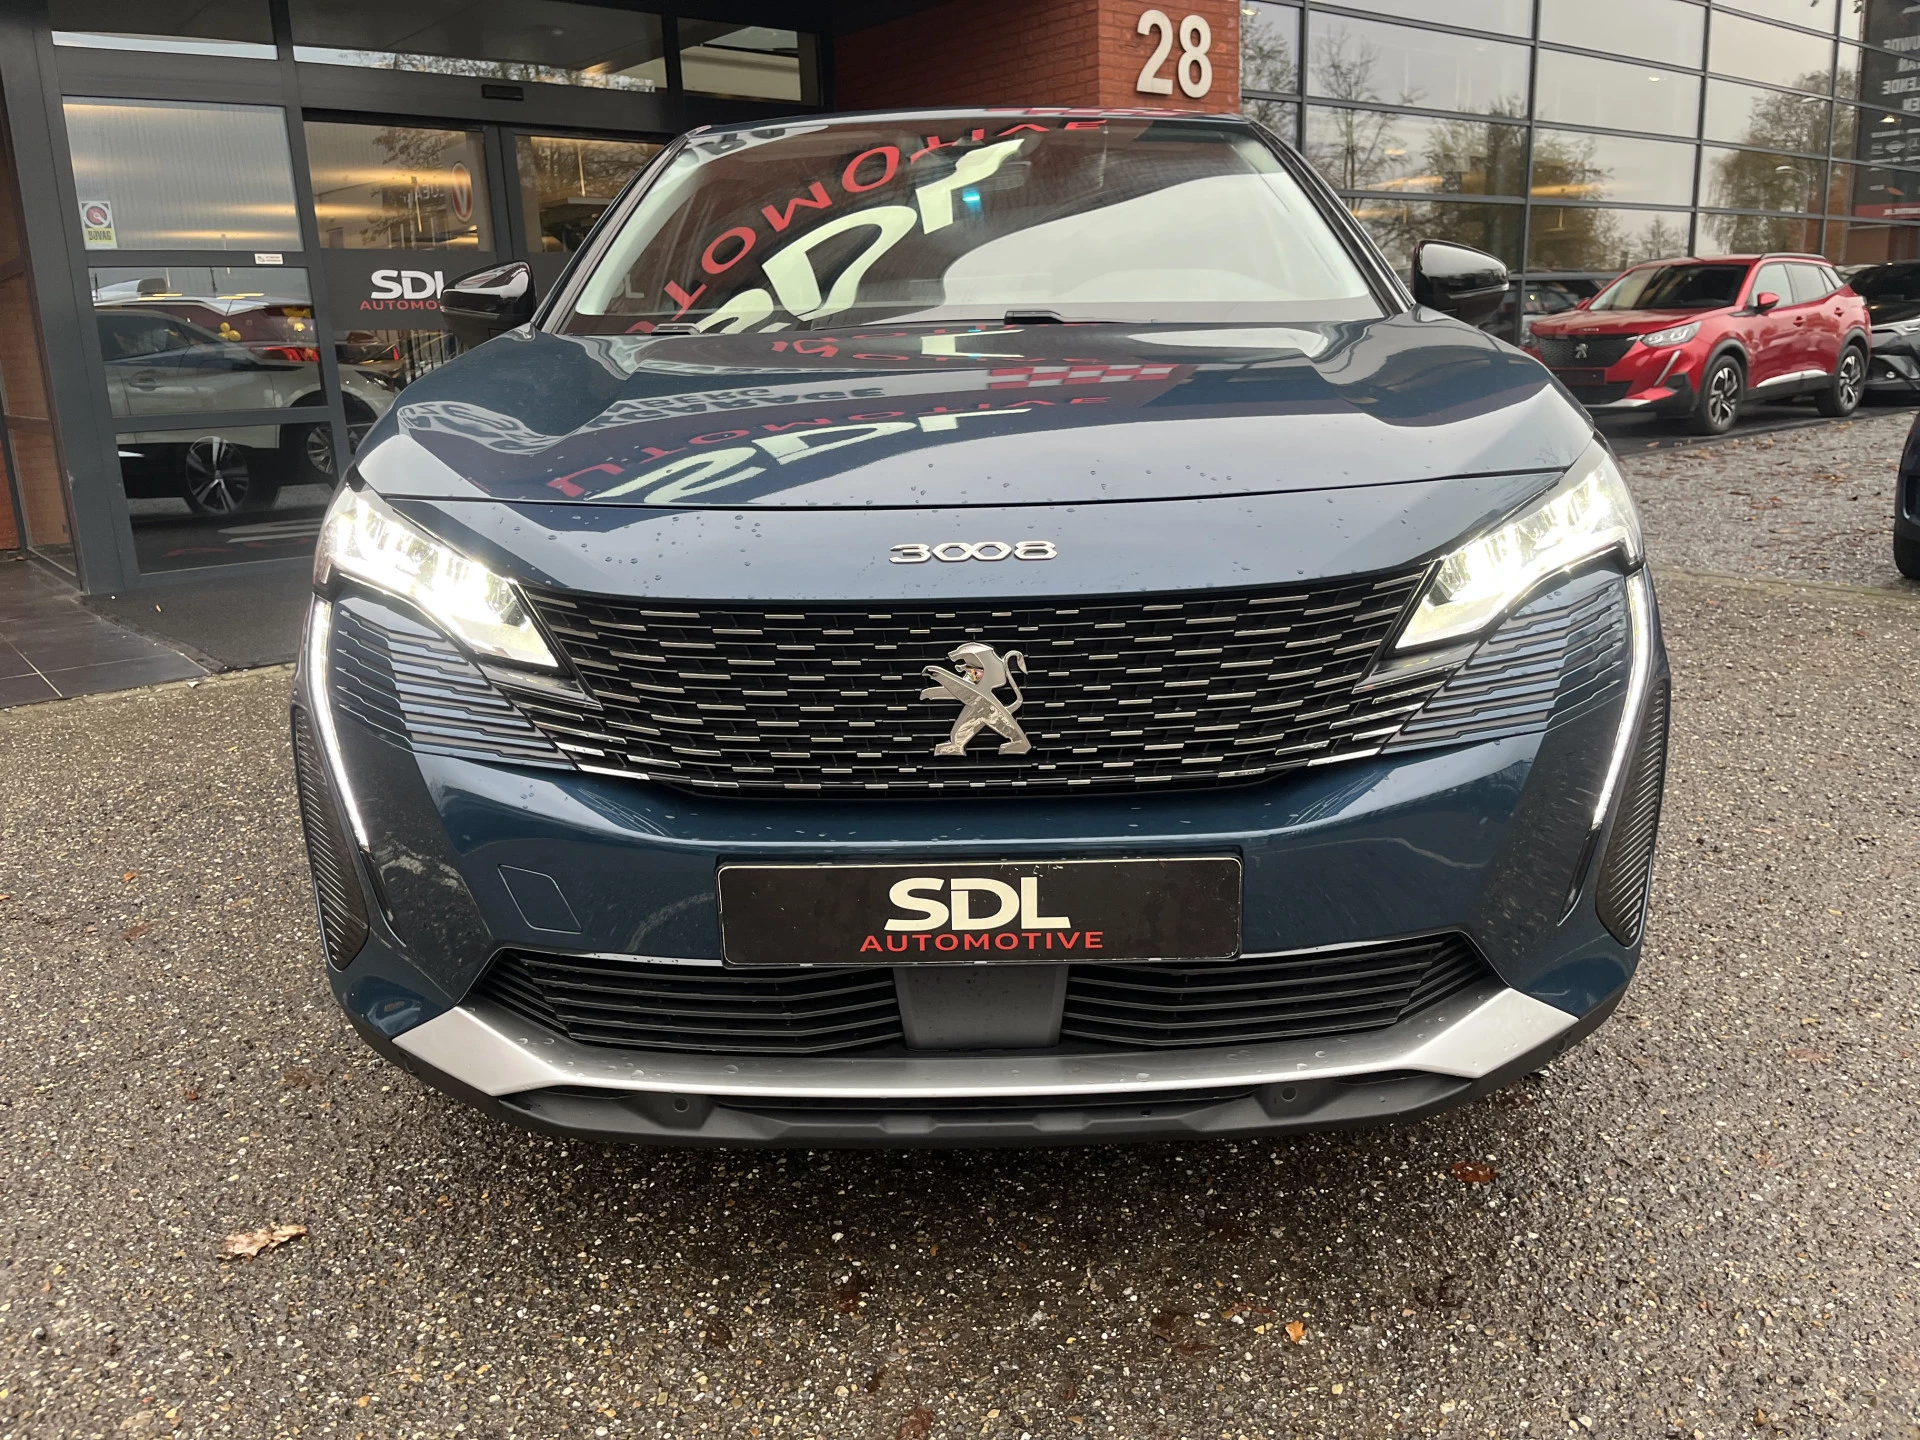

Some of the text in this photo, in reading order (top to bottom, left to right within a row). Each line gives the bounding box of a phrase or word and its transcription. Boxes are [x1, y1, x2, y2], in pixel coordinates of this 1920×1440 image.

[1136, 9, 1213, 98] 28
[88, 230, 112, 241] BOVAG
[360, 300, 440, 311] AUTOMO
[889, 540, 1058, 564] 3008
[884, 876, 1072, 931] SDL
[859, 931, 1104, 953] AUTOMOTIVE
